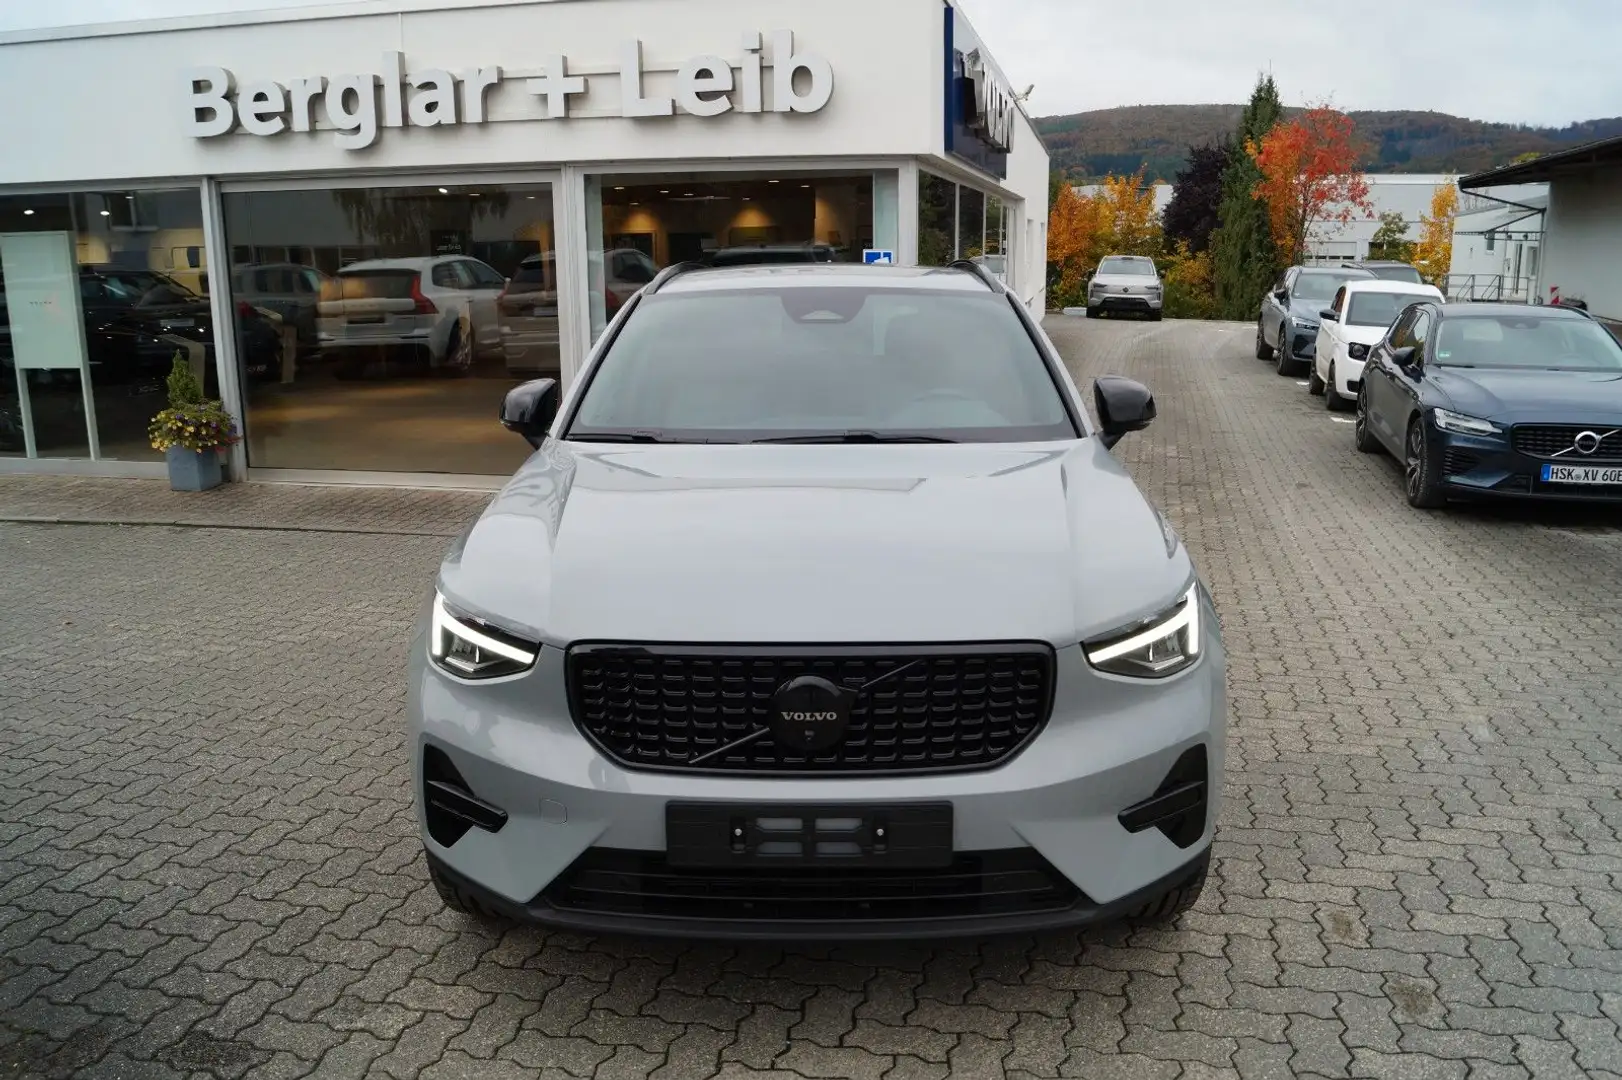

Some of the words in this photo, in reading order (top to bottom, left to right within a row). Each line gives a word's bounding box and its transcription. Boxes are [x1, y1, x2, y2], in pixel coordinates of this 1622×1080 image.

[187, 50, 502, 151] Berglar
[620, 29, 835, 117] Leib
[1551, 467, 1575, 481] HSK
[1582, 469, 1599, 482] XV
[781, 711, 838, 721] VOLVO
